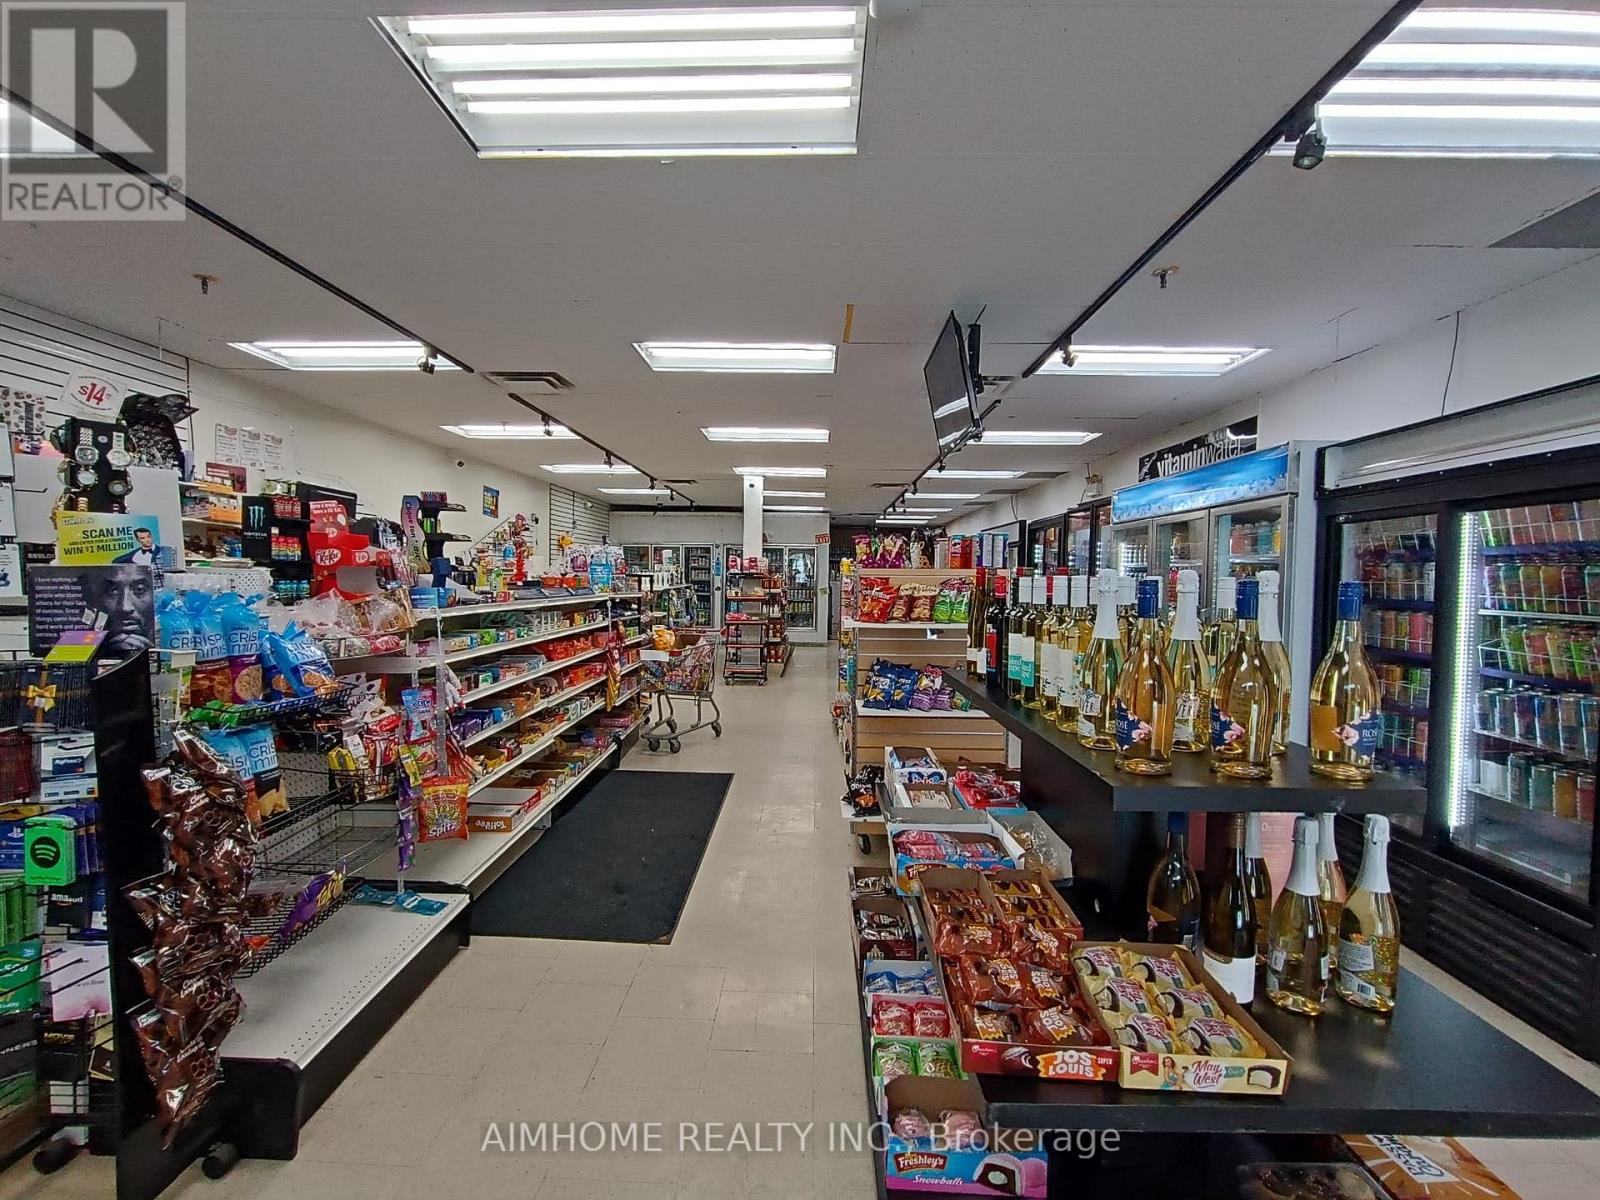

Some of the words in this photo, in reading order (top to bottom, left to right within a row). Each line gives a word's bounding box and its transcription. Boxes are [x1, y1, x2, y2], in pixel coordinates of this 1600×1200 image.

[82, 528, 114, 539] SCAN
[116, 527, 132, 535] ME
[63, 547, 83, 555] WIN
[97, 542, 134, 552] MILLION
[428, 822, 458, 837] Spitz
[1053, 1049, 1092, 1066] JOS
[1097, 1057, 1113, 1065] SUPER
[1048, 1064, 1094, 1078] LOUIS
[1192, 1060, 1222, 1074] May
[1193, 1072, 1222, 1086] West
[898, 1154, 945, 1168] Freshley's
[913, 1174, 963, 1186] Snowballs
